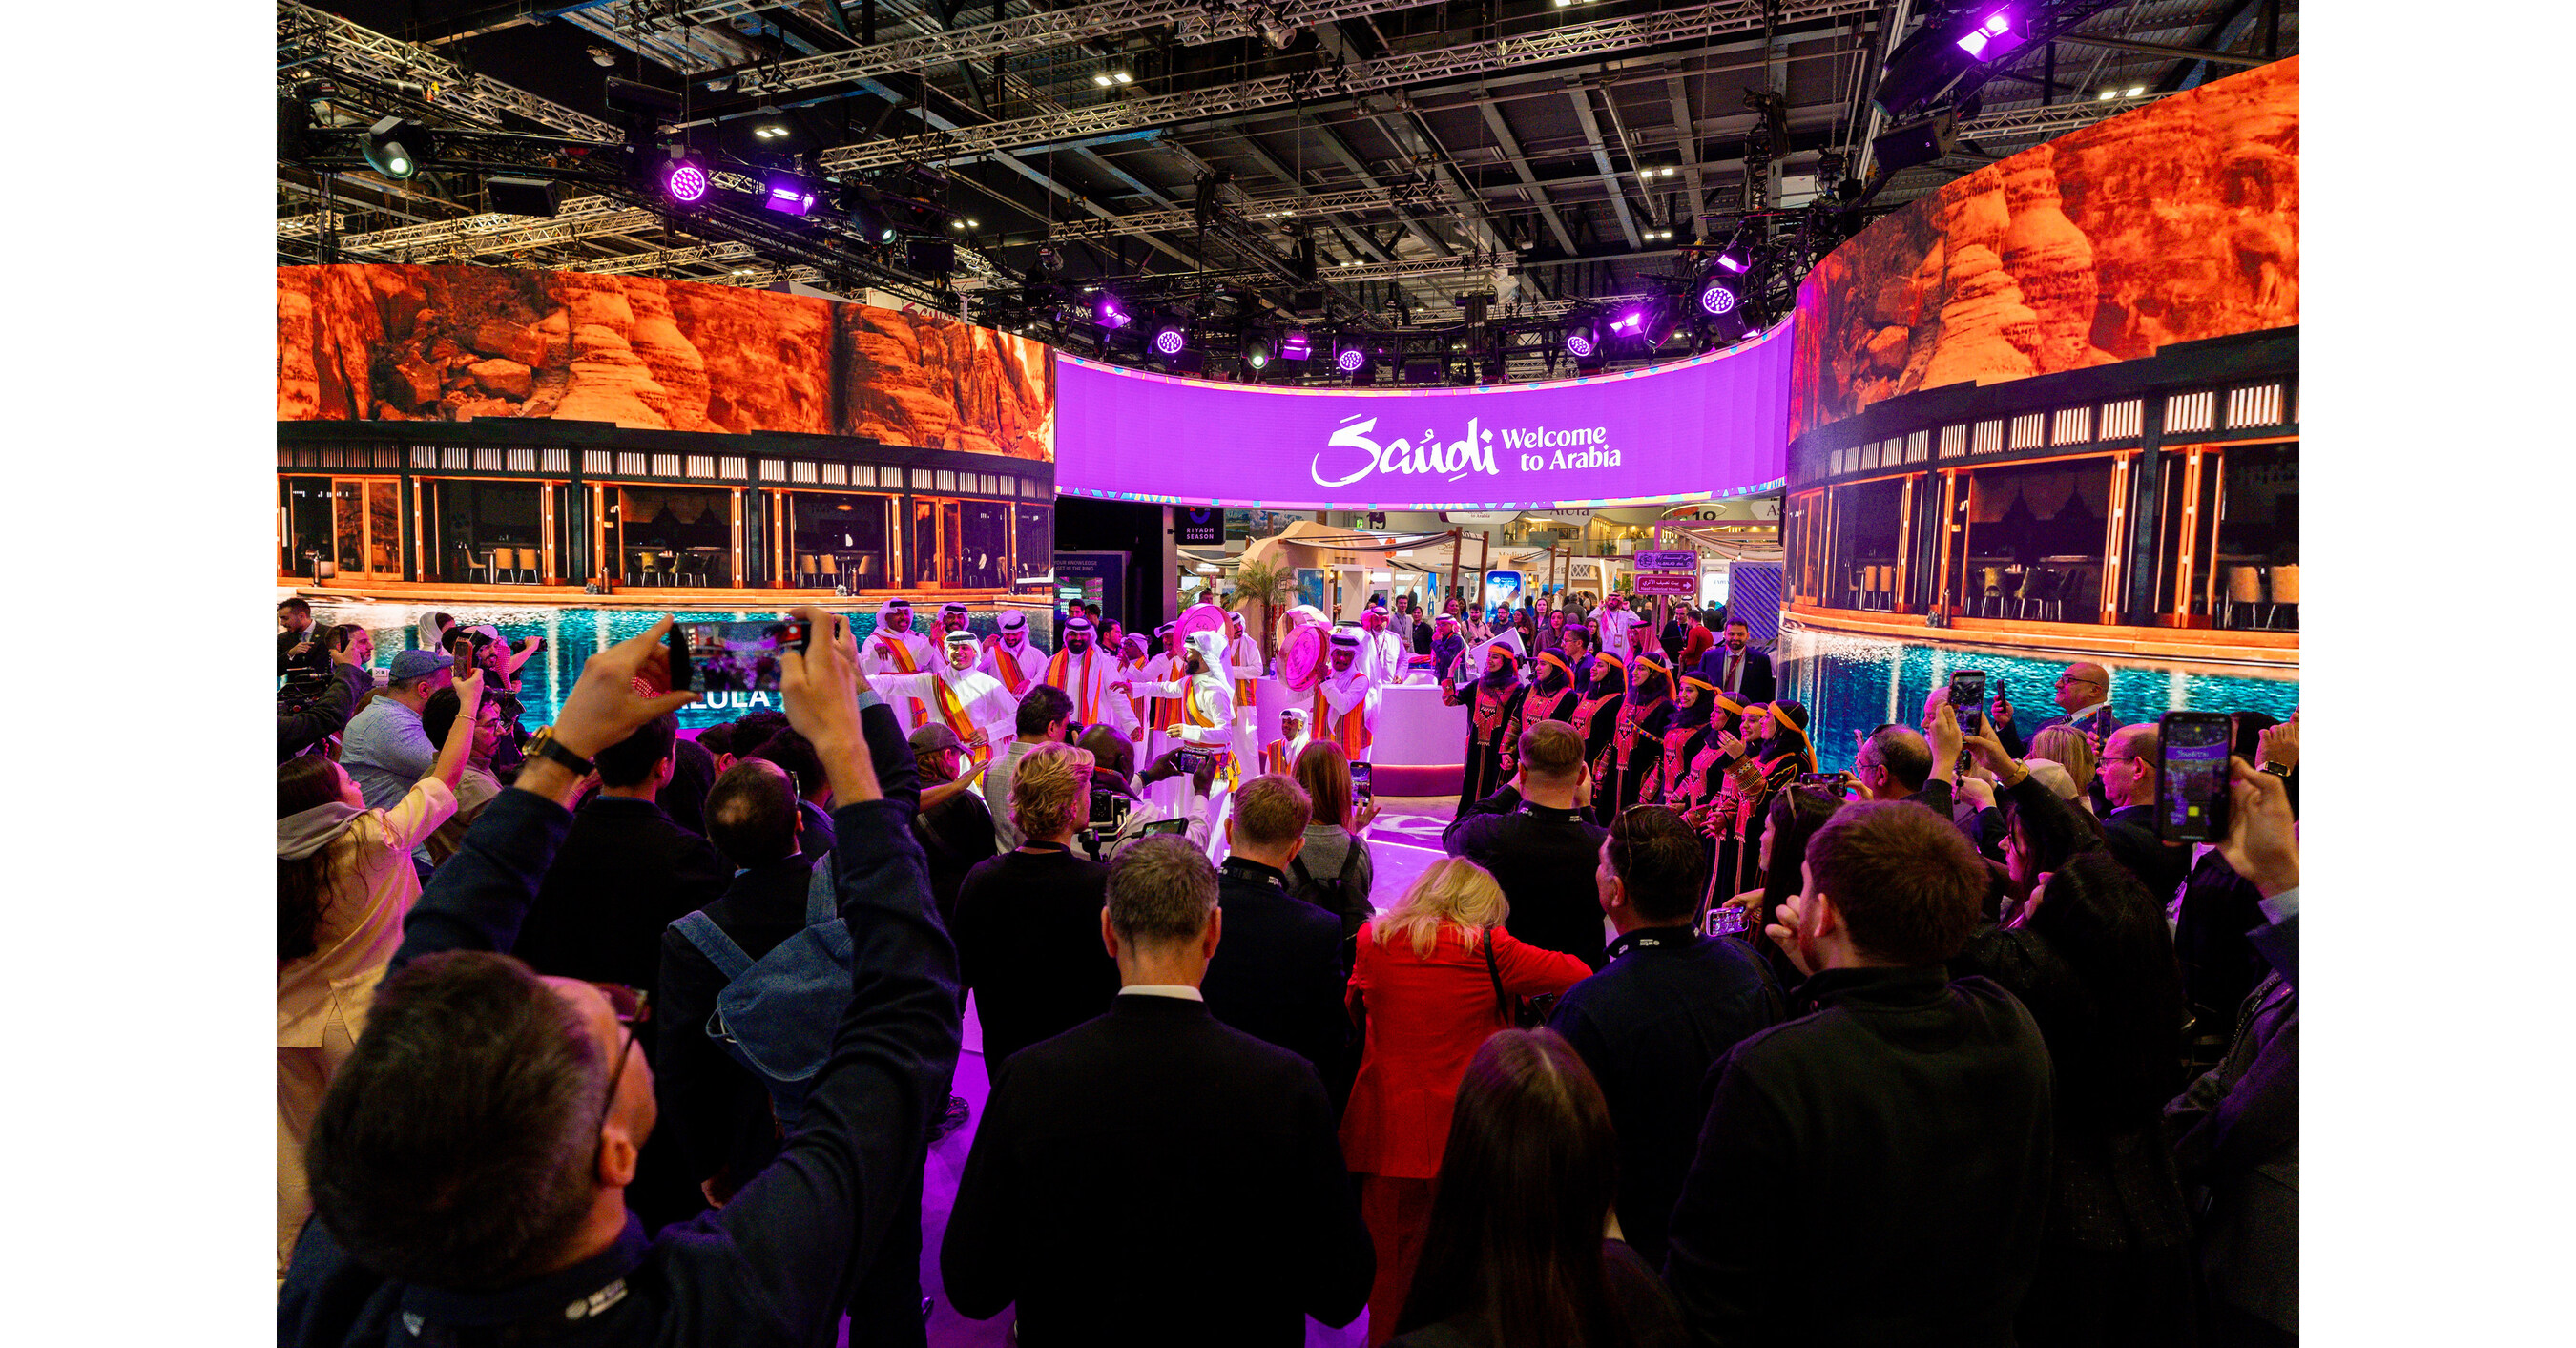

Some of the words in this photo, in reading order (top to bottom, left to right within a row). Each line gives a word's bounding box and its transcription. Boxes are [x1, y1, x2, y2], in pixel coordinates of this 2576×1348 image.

[1311, 413, 1500, 487] Saudi
[1501, 426, 1607, 450] Welcome
[1521, 453, 1544, 472] to
[1549, 444, 1622, 470] Arabia
[681, 691, 771, 710] LULA
